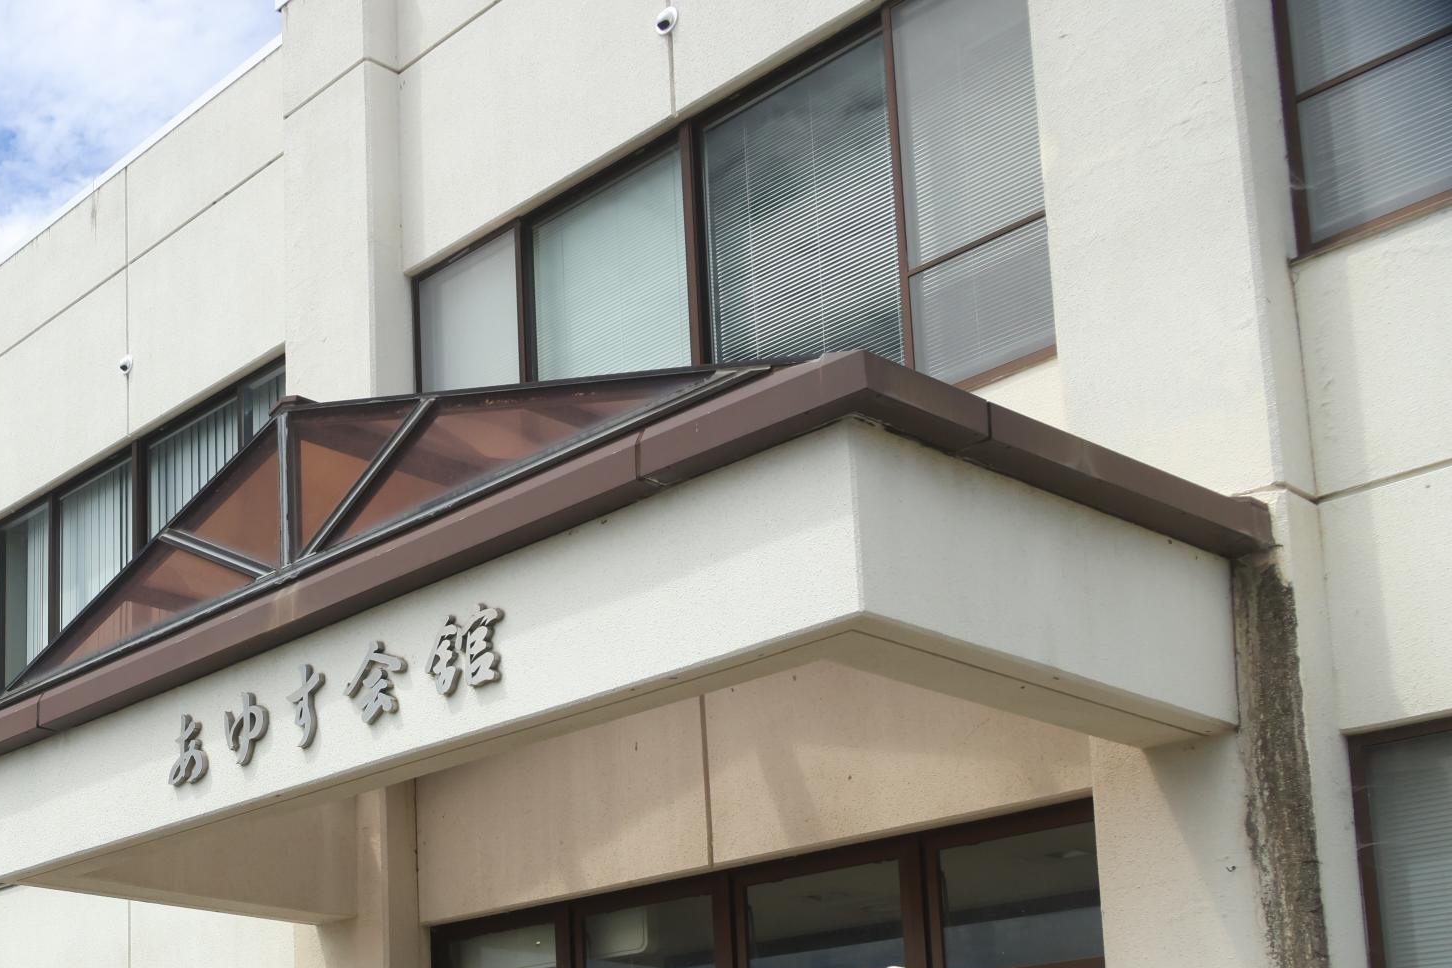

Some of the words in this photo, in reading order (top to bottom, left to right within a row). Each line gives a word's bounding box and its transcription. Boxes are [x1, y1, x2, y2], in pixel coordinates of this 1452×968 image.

[168, 603, 505, 787] あゆす会館
